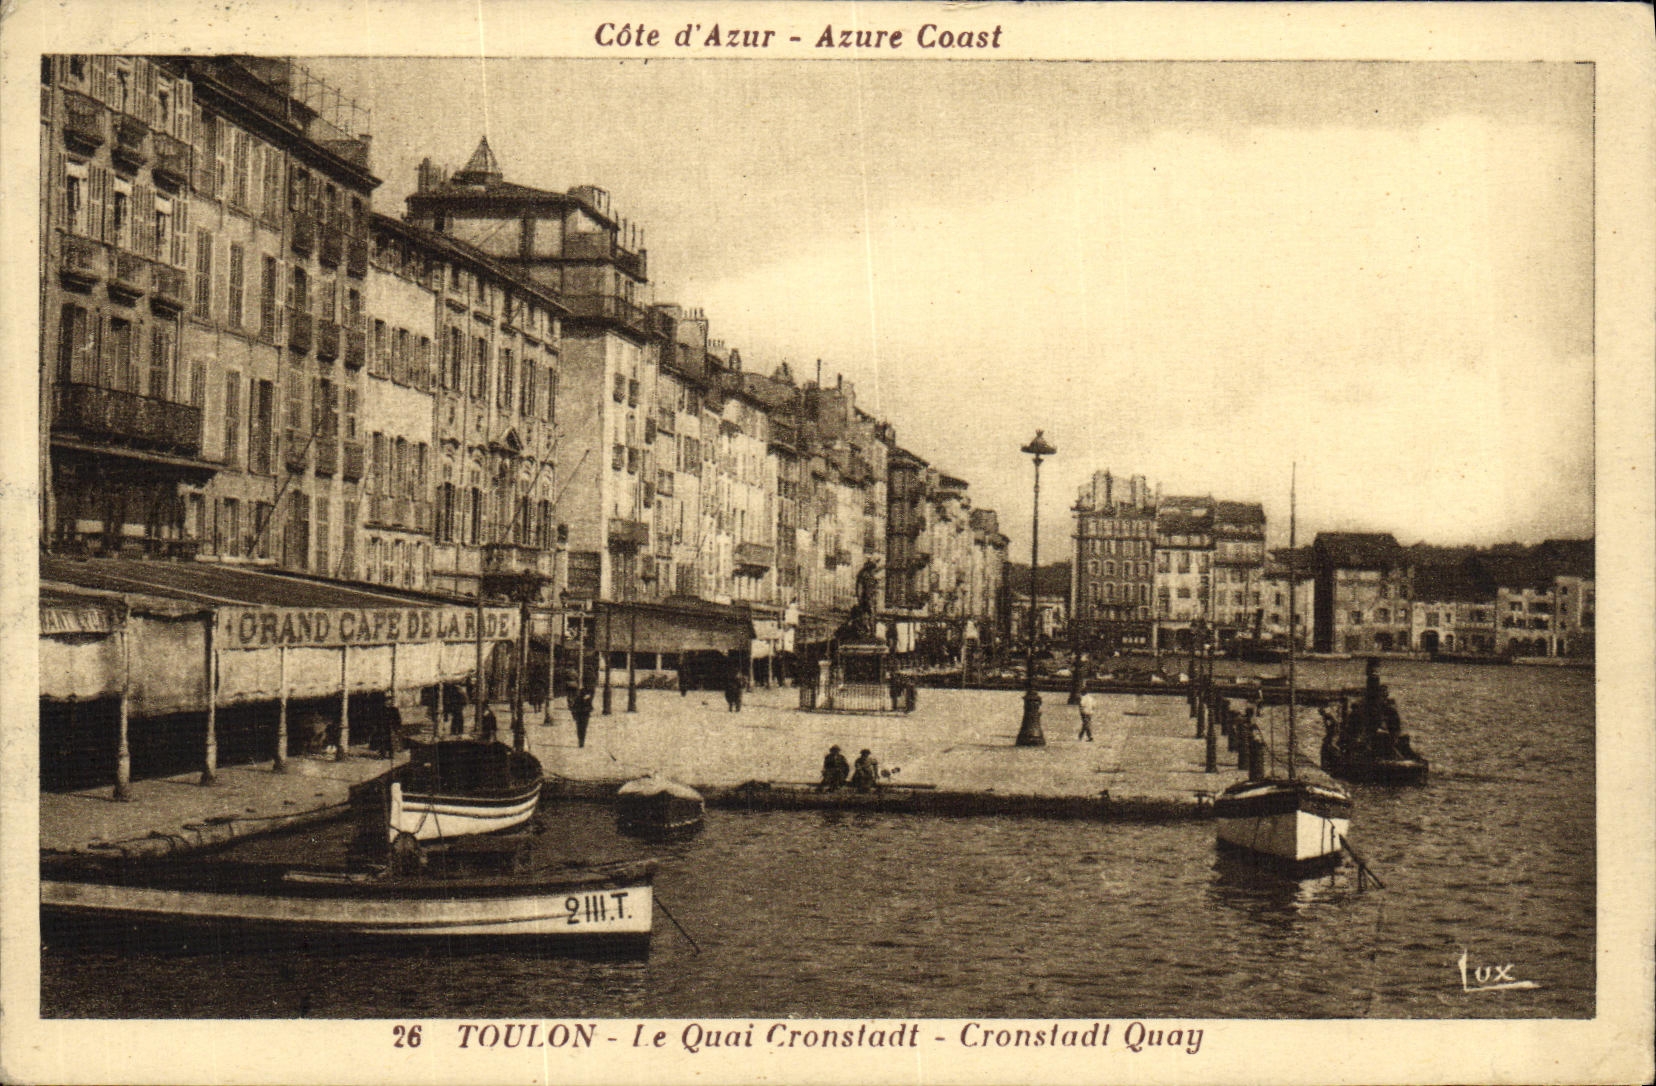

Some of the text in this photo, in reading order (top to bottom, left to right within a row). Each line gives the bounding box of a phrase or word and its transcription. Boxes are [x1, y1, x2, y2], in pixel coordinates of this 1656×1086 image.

[239, 611, 330, 645] GRAND
[407, 610, 433, 640] DE
[436, 611, 461, 639] LA
